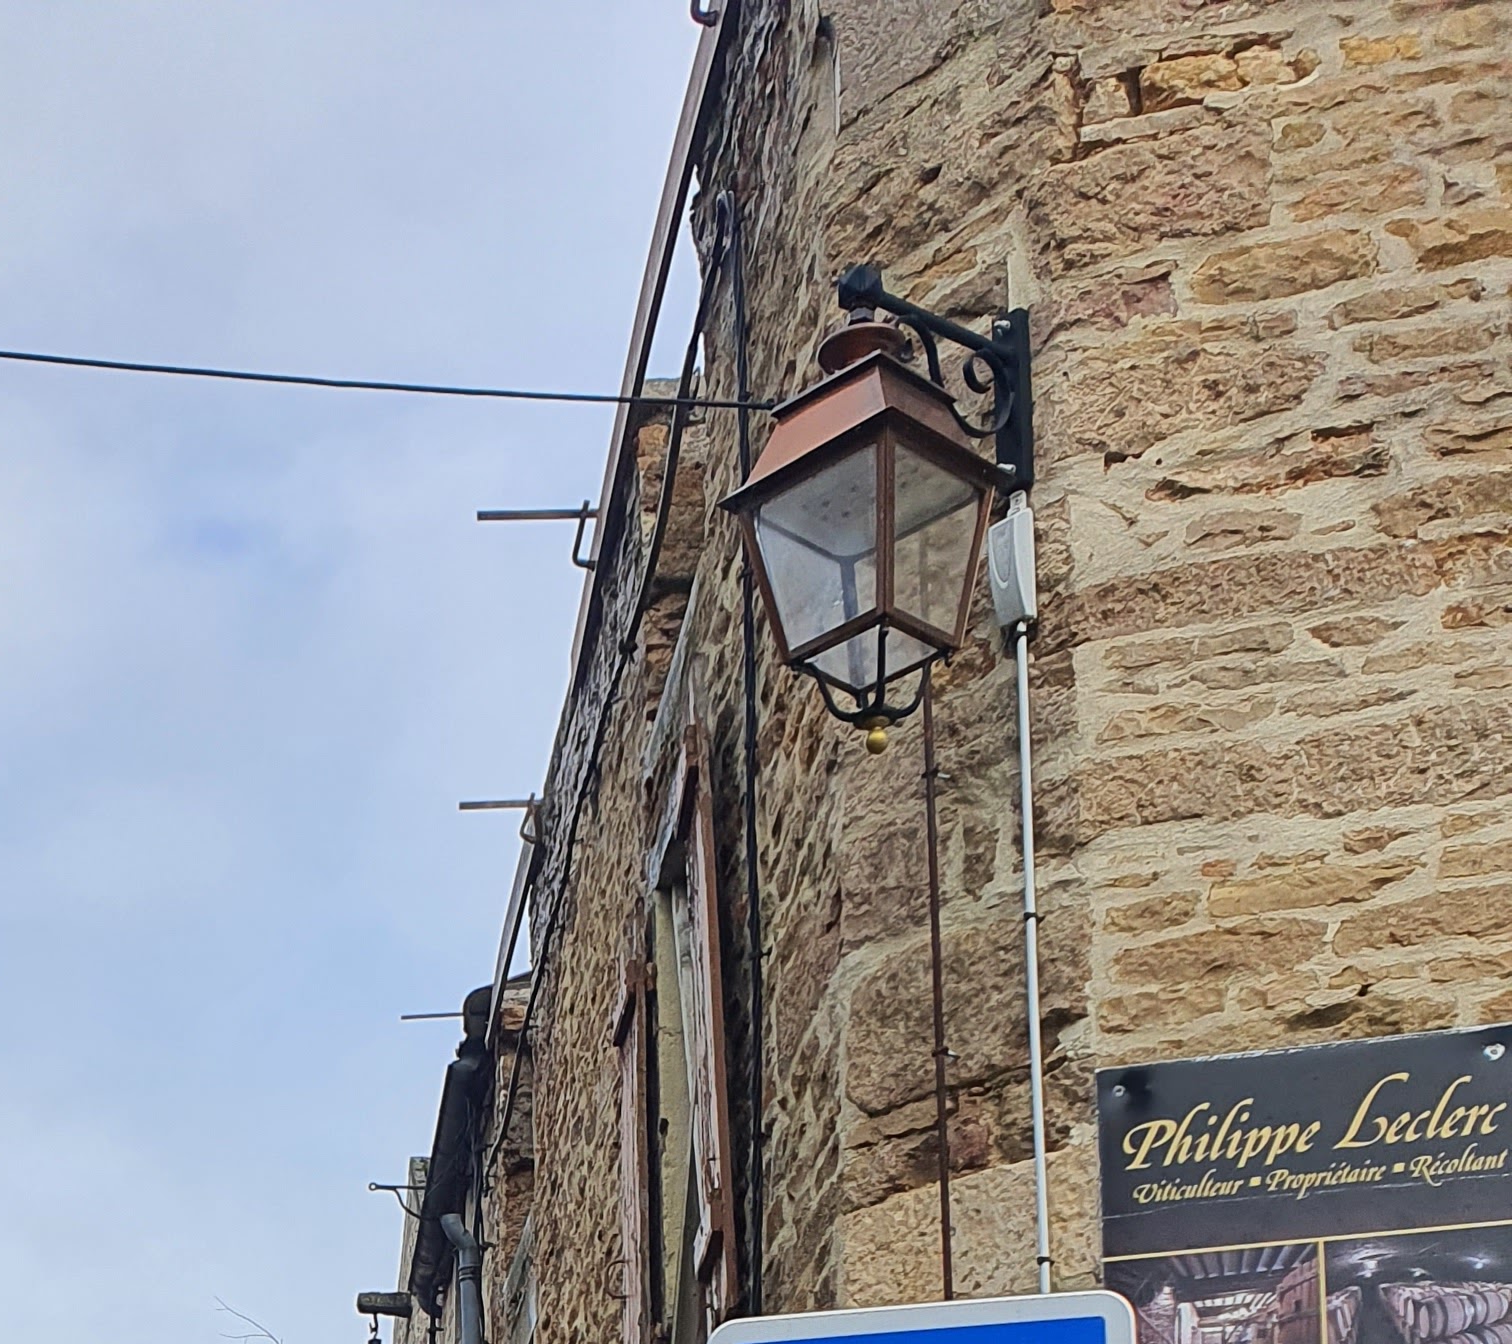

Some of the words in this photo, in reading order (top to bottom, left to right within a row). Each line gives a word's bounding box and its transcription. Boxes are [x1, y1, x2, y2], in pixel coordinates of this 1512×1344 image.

[1123, 1098, 1321, 1171] Philippe
[1332, 1072, 1507, 1150] Leclerc
[1132, 1169, 1244, 1204] Viticulteur
[1265, 1159, 1386, 1200] Propriétaire
[1409, 1142, 1508, 1187] Récoltant
